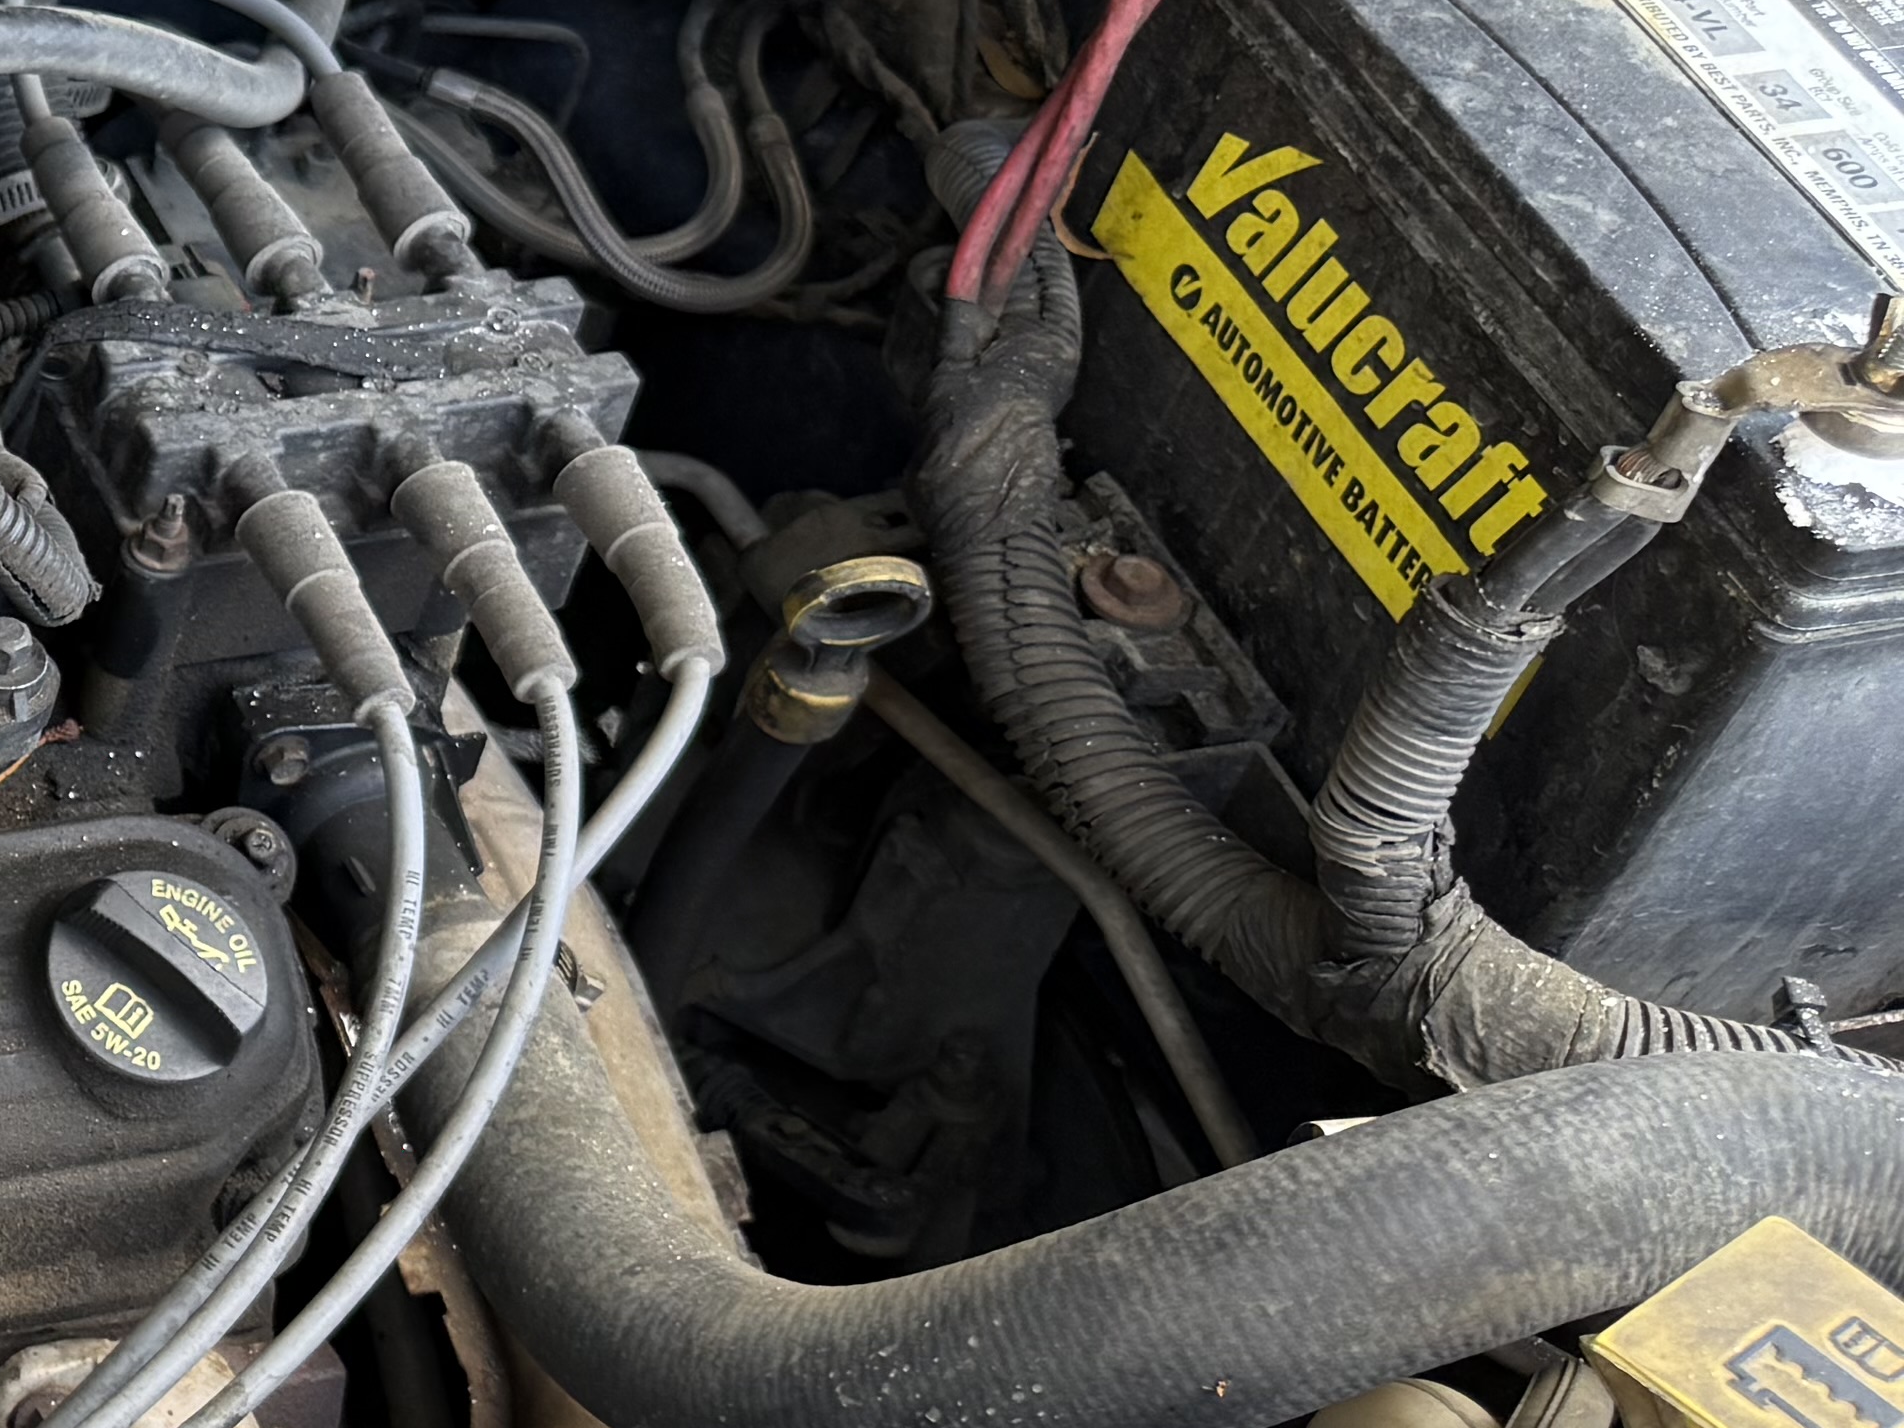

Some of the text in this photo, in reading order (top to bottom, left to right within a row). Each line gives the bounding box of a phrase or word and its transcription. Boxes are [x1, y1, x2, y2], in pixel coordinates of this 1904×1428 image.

[1808, 0, 1839, 18] TIP.
[1826, 19, 1855, 33] DO
[1839, 32, 1871, 51] NOT
[1756, 82, 1803, 111] 34
[1805, 67, 1845, 95] Group
[1681, 44, 1707, 60] BY
[1698, 62, 1739, 92] BEST
[1727, 94, 1779, 135] PARTS,
[1802, 170, 1872, 231] MEMPHIS,
[1864, 234, 1890, 250] TN
[1819, 146, 1881, 190] 600
[1185, 131, 1549, 556] Valucraft
[1199, 306, 1432, 595] AUTOMOTIVE BATTER
[151, 879, 257, 973] ENGINE OIL
[399, 898, 417, 940] TEMP
[62, 979, 161, 1070] SAE 5W-20
[323, 1051, 377, 1146] SUPPRESSOR
[200, 1253, 220, 1271] HI
[222, 1213, 257, 1249] TEMP
[436, 1010, 454, 1028] HI
[294, 1179, 312, 1196] HI
[264, 1204, 296, 1242] TEMP
